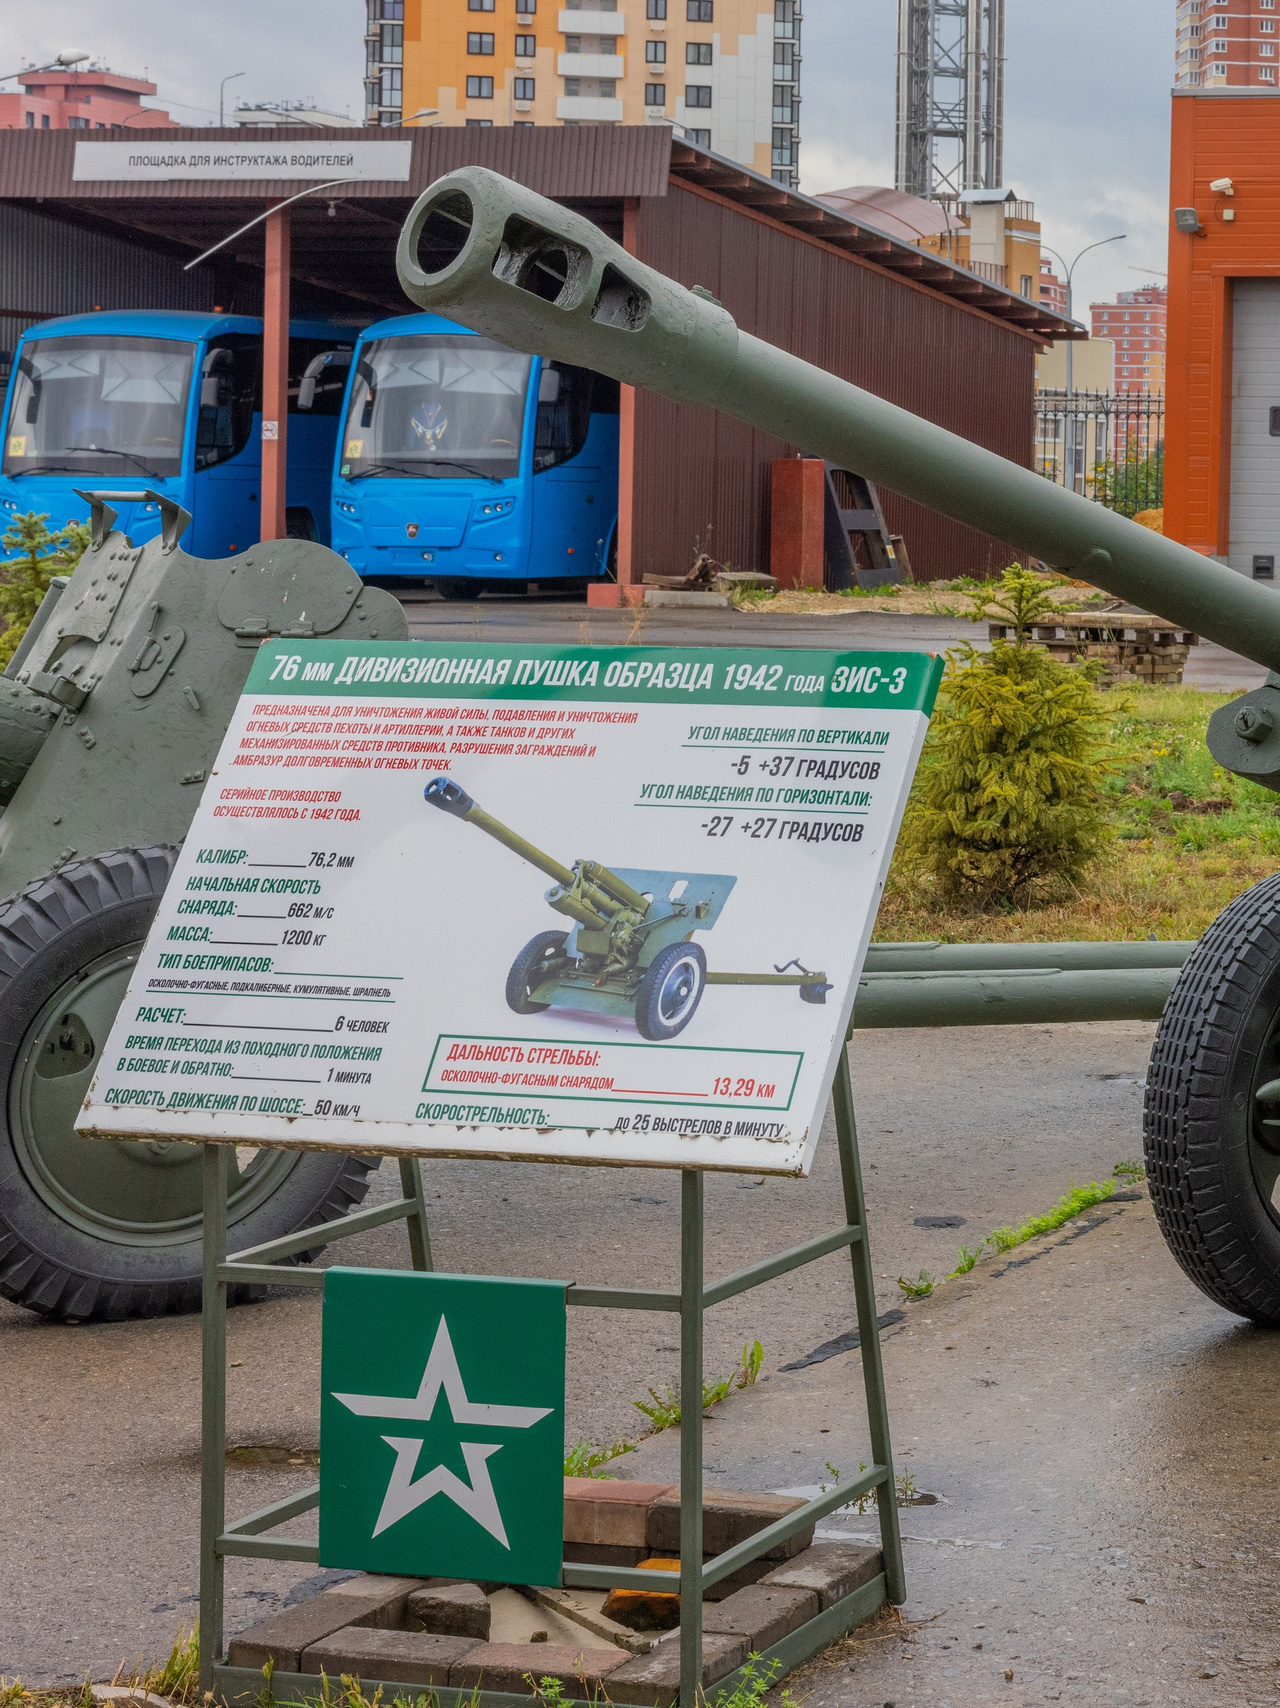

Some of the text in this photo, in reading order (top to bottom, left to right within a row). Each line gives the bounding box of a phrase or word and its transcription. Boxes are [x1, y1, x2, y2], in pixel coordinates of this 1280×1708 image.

[129, 154, 353, 167] ПЛОЩАДКА ДЛЯ ИНСТРУКТАЖА ВОДИТЕЛЕЙ
[269, 655, 299, 680] 76
[334, 657, 512, 684] ДИВИЗИОННАЯ
[512, 660, 597, 686] ПУШКА
[604, 661, 714, 692] ОБРАЗЦА
[724, 664, 783, 690] 1942
[831, 666, 907, 694] ЗИС-3
[252, 705, 638, 723] ПРЕДНАЗНАЧЕНА ДЛЯ УНИЧТОЖЕНИЯ ЖИВОЙ СИЛЫ, ПОДАВЛЕНИЯ И УНИЧТОЖЕНИЯ
[246, 721, 576, 739] ОГНЕВЫХ СРЕДСТВ ПЕХОТЫ И АРТИЛЛЕРИИ, А ТАКЖЕ ТАНКОВ И ДРУГИХ
[688, 726, 890, 745] УГОЛ НАВЕДЕНИЯ ПО ВЕРТИКАЛИ
[239, 738, 596, 757] МЕХАНИЗИРОВАННЫХ СРЕДСТВ ПРОТИВНИКА, РАЗРУШЕНИЯ ЗАГРАЖДЕНИЙ И
[233, 755, 451, 770] АМБРАЗУР ДОЛГОВРЕМЕННЫХ ОГНЕВЫХ ТОЧЕК.
[796, 759, 881, 780] ГРАДУСОВ
[220, 787, 341, 803] СЕРИЙНОЕ ПРОИЗВОДСТВО
[640, 784, 872, 806] УГОЛ НАВЕДЕНИЯ ПО ГОРИЗОНТАЛИ:
[213, 806, 360, 821] ОСУЩЕСТВЛЯЛОСЬ С 1942 ГОДА.
[778, 821, 864, 843] ГРАДУСОВ
[196, 849, 248, 864] КАЛИБР:
[308, 852, 337, 868] 76,2
[186, 876, 321, 894] НАЧАЛЬНАЯ СКОРОСТЬ
[177, 899, 237, 917] СНАРЯДА:
[288, 903, 313, 918] 662
[167, 926, 213, 941] МАССА:
[282, 930, 313, 945] 1200
[157, 954, 274, 972] ТИП БОЕПРИПАСОВ:
[148, 978, 391, 997] ОСКОЛОЧНО-ФУГАСНЫЕ, ПОДКАЛИБЕРНЫЕ, КУМУЛЯТИВНЫЕ, ШРАПНЕЛЬ
[135, 1007, 390, 1033] РАСЧЕТ: 6 ЧЕЛОВЕК
[125, 1035, 383, 1061] ВРЕМЯ ПЕРЕХОДА ИЗ ПОХОДНОГО ПОЛОЖЕНИЯ
[446, 1044, 601, 1066] ДАЛЬНОСТЬ СТРЕЛЬБЫ:
[116, 1057, 372, 1084] В БОЕВОЕ И ОБРАТНО: 1 МИНУТА
[441, 1070, 559, 1086] ОСКОЛОЧНО-ФУГАСНЫМ
[560, 1075, 614, 1090] СНАРЯДОМ
[713, 1077, 755, 1098] 13,29
[104, 1088, 165, 1105] СКОРОСТЬ
[166, 1091, 239, 1109] ДВИЖЕНИЯ
[239, 1096, 258, 1111] ПО
[258, 1096, 306, 1114] ШОССЕ:
[314, 1100, 332, 1115] 50
[415, 1103, 550, 1125] СКОРОСТРЕЛЬНОСТЬ:
[632, 1114, 651, 1130] 25
[652, 1117, 722, 1135] ВЫСТРЕЛОВ
[723, 1121, 733, 1135] В
[734, 1121, 784, 1138] МИНУТУ
